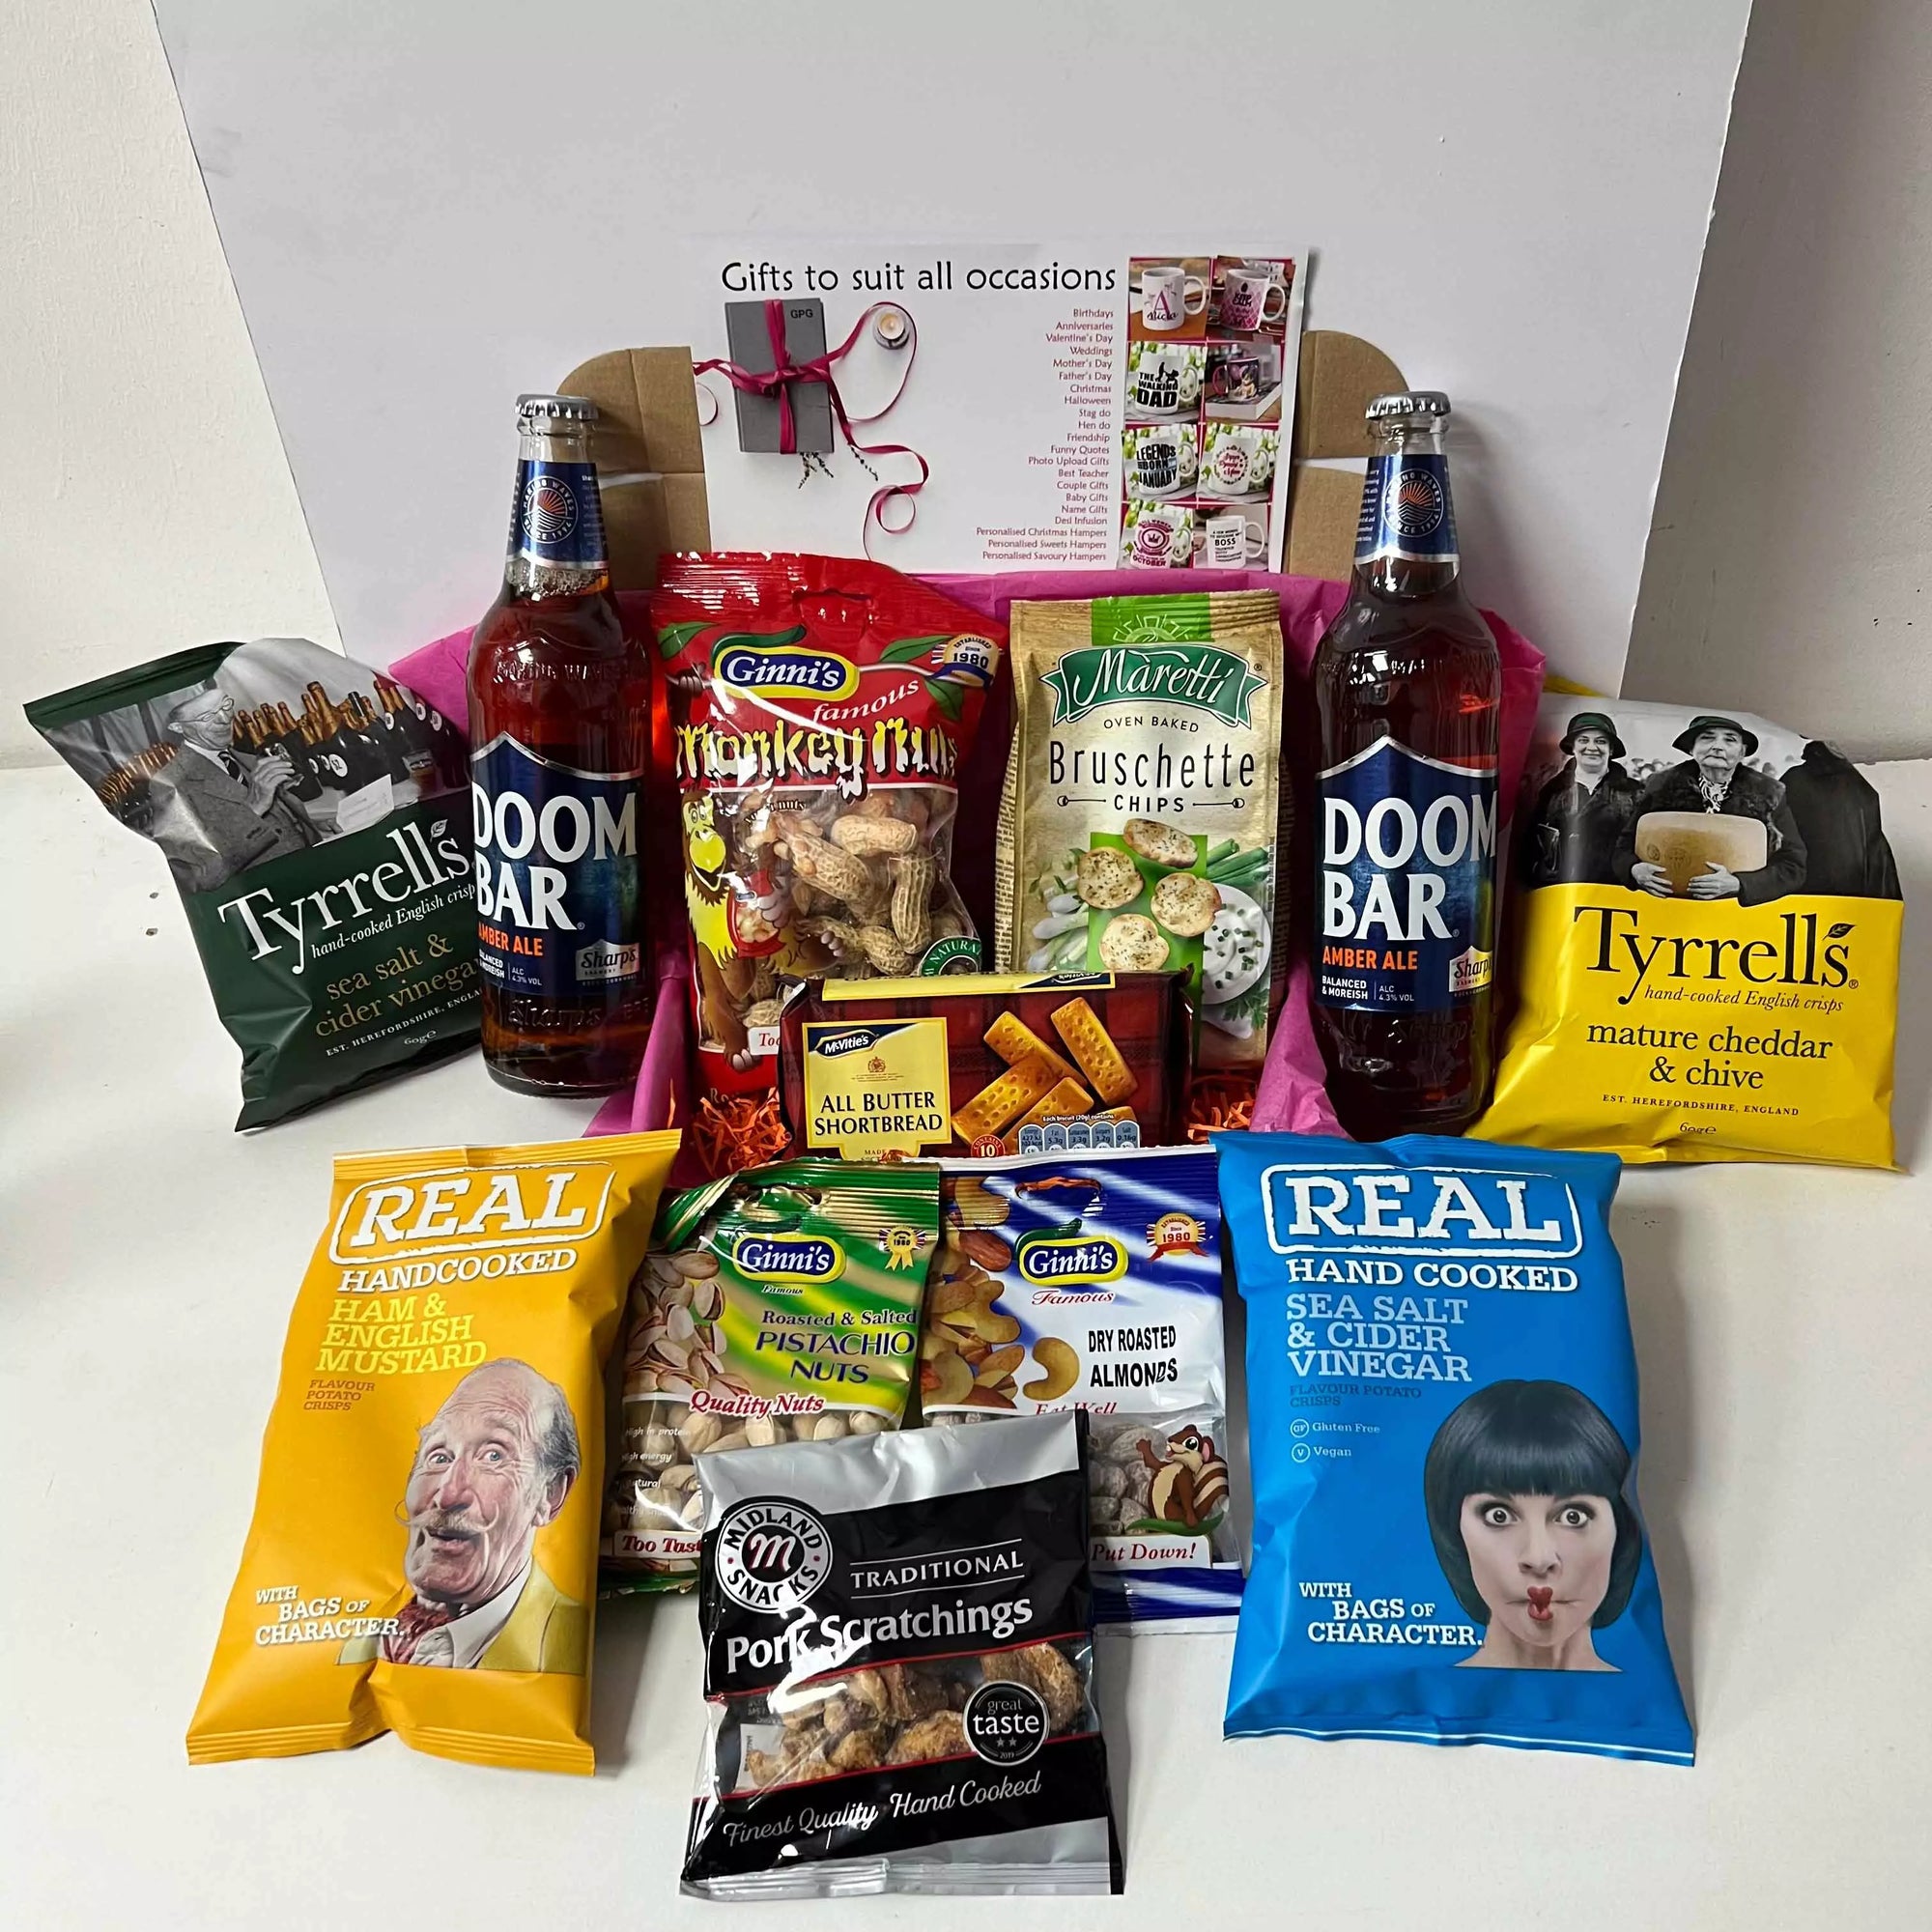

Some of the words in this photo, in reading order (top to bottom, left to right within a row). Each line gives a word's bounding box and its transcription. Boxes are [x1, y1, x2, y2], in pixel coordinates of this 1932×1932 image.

[721, 262, 793, 291] Gifts
[805, 266, 838, 291] to
[852, 262, 905, 291] suit
[918, 261, 952, 290] all
[966, 262, 1116, 291] occasions
[790, 308, 813, 320] GPG
[1073, 309, 1114, 319] Birthdays
[1055, 322, 1114, 330] Anniversaries
[1045, 333, 1093, 342] Valentine's
[1095, 334, 1113, 344] Day
[1069, 346, 1113, 356] Weddings
[1053, 358, 1092, 367] Mother's
[1094, 359, 1112, 370] Day
[1059, 371, 1092, 381] Father's
[1094, 372, 1112, 383] Day
[1140, 371, 1154, 382] THE
[1069, 384, 1112, 393] Christmas
[1137, 387, 1178, 408] DAD
[1065, 395, 1111, 405] Halloween
[1079, 409, 1096, 419] Stag
[1099, 409, 1111, 417] do
[1098, 421, 1111, 430] do
[1066, 432, 1110, 443] Friendship
[1050, 444, 1076, 455] Funny
[1079, 445, 1110, 455] Quotes
[1137, 443, 1177, 461] LEGENDS
[1056, 457, 1088, 467] Upload
[1090, 457, 1110, 466] Gifts
[1057, 481, 1087, 491] Couple
[1090, 481, 1109, 490] Gifts
[1065, 493, 1087, 503] Baby
[1089, 505, 1108, 514] Gifts
[977, 527, 1026, 536] Personalised
[1028, 527, 1067, 536] Christmas
[1070, 528, 1107, 538] Hampers
[1214, 538, 1236, 547] BOSS
[988, 539, 1037, 549] Personalised
[1039, 540, 1067, 549] Sweets
[1069, 541, 1106, 550] Hampers
[982, 552, 1032, 560] Personalised
[1034, 552, 1066, 562] Savoury
[953, 652, 989, 669] 1980
[726, 656, 840, 689] Ginni's
[812, 678, 919, 723] famous
[1103, 716, 1143, 729] OVEN
[1151, 716, 1200, 733] BAKED
[1050, 740, 1255, 788] Bruschette
[1114, 794, 1185, 812] CHIPS
[471, 781, 638, 864] DOOM
[1322, 791, 1497, 869] DOOM
[474, 849, 578, 930] BAR
[1322, 870, 1454, 941] BAR
[311, 913, 393, 959] hand-cooked
[396, 895, 444, 926] English
[513, 935, 543, 956] ALE
[326, 971, 371, 1001] sea
[375, 947, 423, 981] salt
[427, 933, 454, 958] &
[1322, 945, 1377, 970] AMBER
[1382, 951, 1419, 971] ALE
[1321, 975, 1367, 989] BALANCED
[315, 997, 382, 1037] cider
[387, 957, 479, 1009] vinega
[1328, 987, 1369, 1000] MOREISH
[1644, 983, 1741, 1007] hand-cooked
[1745, 990, 1800, 1010] English
[1804, 995, 1844, 1016] crisps
[1586, 1023, 1699, 1051] mature
[1708, 1026, 1833, 1060] cheddar
[1649, 1056, 1676, 1083] &
[1686, 1059, 1765, 1090] chive
[821, 1094, 855, 1113] ALL
[864, 1092, 935, 1112] BUTTER
[1744, 1105, 1800, 1117] ENGLAND
[815, 1114, 943, 1136] SHORTBREAD
[350, 1172, 586, 1247] REAL
[1285, 1176, 1563, 1241] REAL
[1163, 1233, 1191, 1243] 1980
[741, 1243, 831, 1272] Ginni's
[1029, 1245, 1114, 1275] Ginni's
[337, 1248, 577, 1293] HANDCOOKED
[1286, 1259, 1404, 1285] HAND
[1413, 1264, 1578, 1292] COOKED
[761, 1284, 804, 1295] Famous
[1032, 1290, 1114, 1305] Famous
[328, 1297, 416, 1323] HAM
[423, 1292, 446, 1319] &
[761, 1310, 835, 1326] Roasted
[840, 1312, 856, 1326] &
[861, 1309, 918, 1324] Salted
[1286, 1293, 1363, 1321] SEA
[1374, 1295, 1468, 1324] SALT
[323, 1314, 475, 1349] ENGLISH
[1088, 1330, 1113, 1353] DRY
[1118, 1325, 1177, 1351] ROASTED
[1287, 1321, 1316, 1349] &
[1327, 1322, 1451, 1352] CIDER
[755, 1331, 916, 1356] PISTACHIO
[315, 1341, 488, 1375] MUSTARD
[1287, 1350, 1472, 1382] VINEGAR
[790, 1360, 869, 1383] NUTS
[1090, 1358, 1179, 1387] ALMONDS
[309, 1378, 375, 1392] FLAVOUR
[1290, 1383, 1359, 1397] FLAVOUR
[1363, 1385, 1422, 1399] POTATO
[303, 1401, 353, 1411] CRISPS
[306, 1390, 361, 1402] POTATO
[691, 1390, 773, 1420] Quality
[774, 1394, 825, 1413] Nuts
[1290, 1395, 1341, 1408] CRISPS
[1313, 1422, 1352, 1432] Gluten
[1354, 1423, 1380, 1434] Free
[1314, 1446, 1351, 1458] Vegan
[724, 1506, 823, 1550] MIDLAND
[622, 1535, 657, 1552] Too
[1092, 1544, 1125, 1561] Put
[1130, 1543, 1197, 1560] Down!
[850, 1550, 1025, 1589] TRADITIONAL
[255, 1585, 298, 1605] WITH
[1299, 1582, 1351, 1598] WITH
[278, 1597, 342, 1623] BAGS
[345, 1600, 371, 1614] OF
[1332, 1598, 1406, 1620] BAGS
[1410, 1603, 1435, 1617] OF
[255, 1617, 406, 1645] CHARACTER.
[726, 1625, 810, 1674] Pork
[820, 1599, 1034, 1649] Scratchings
[1307, 1622, 1482, 1646] CHARACTER.
[987, 1698, 1023, 1716] great
[973, 1713, 1039, 1735] taste
[724, 1818, 794, 1847] Finest
[800, 1803, 878, 1833] Quality
[890, 1792, 955, 1818] Hand
[959, 1771, 1042, 1805] Cooked
